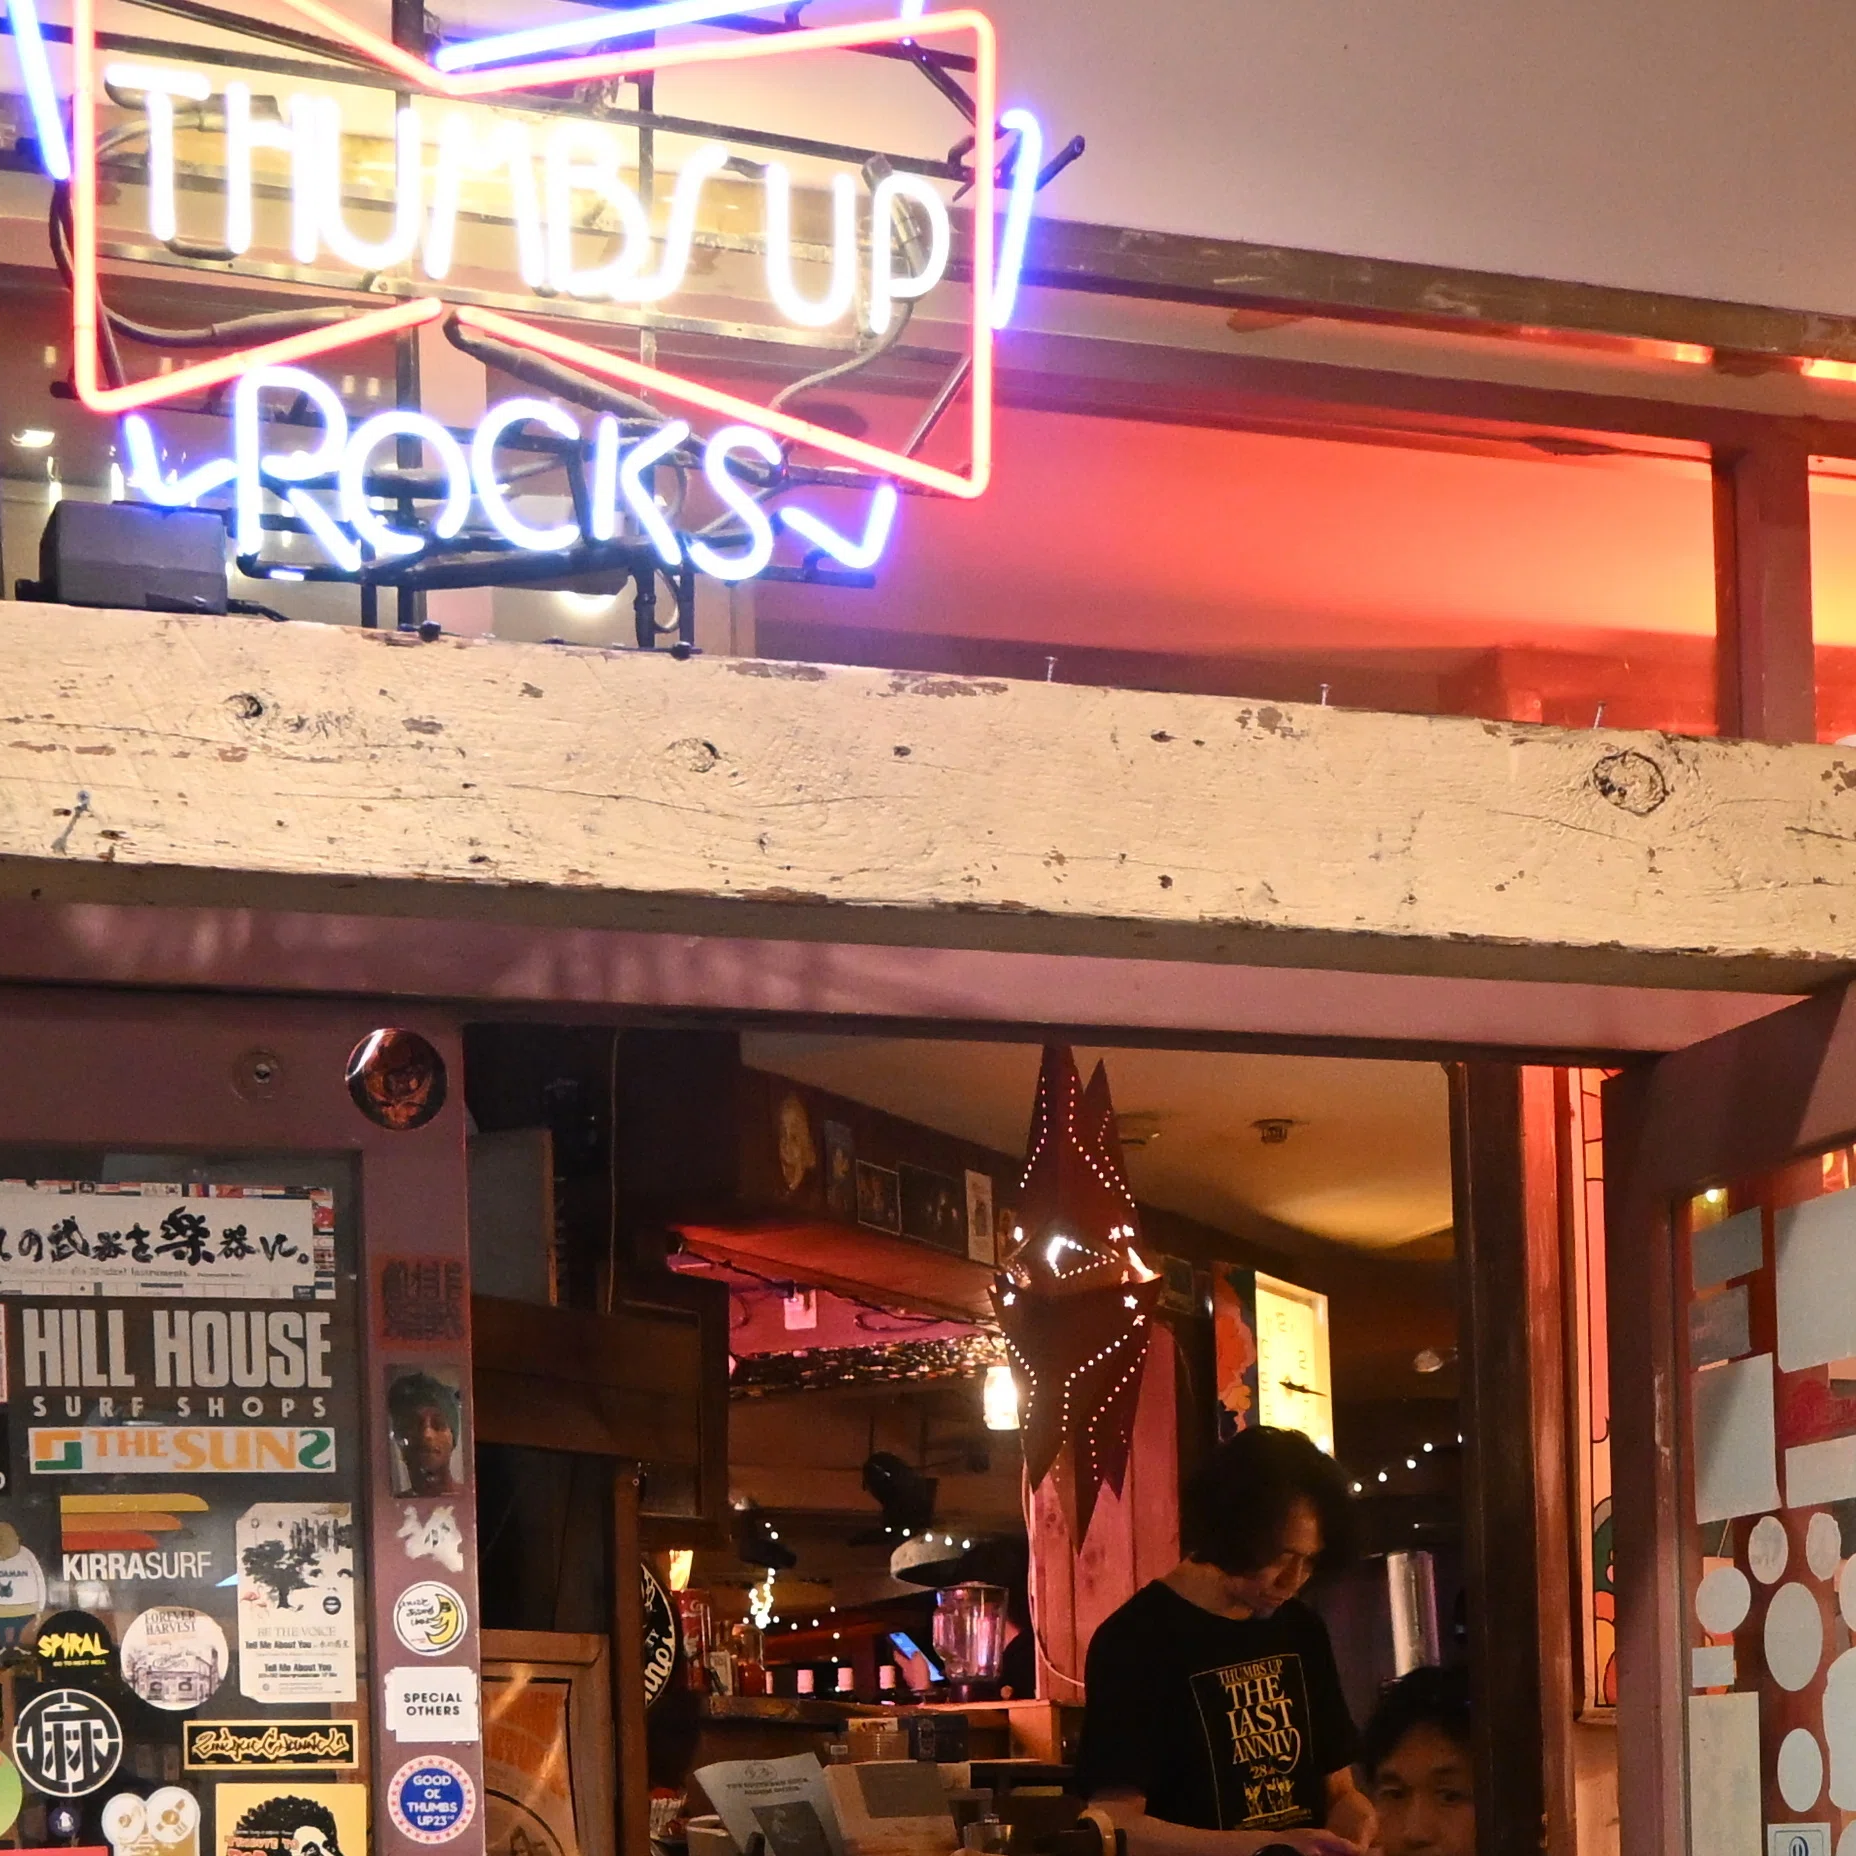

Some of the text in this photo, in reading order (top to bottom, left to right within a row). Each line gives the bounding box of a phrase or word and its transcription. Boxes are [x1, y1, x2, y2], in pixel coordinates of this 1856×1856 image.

[105, 61, 950, 336] THUMBS UP
[235, 364, 784, 581] ROCKS
[23, 1309, 332, 1389] HILL HOUSE
[33, 1396, 328, 1418] SURF SHOPS
[62, 1551, 213, 1582] KIRRASURF
[145, 1611, 195, 1624] FOREVER
[146, 1621, 197, 1634] HARVEST
[38, 1632, 110, 1659] SPIRAL
[1218, 1659, 1285, 1688] THUMBS UP
[403, 1692, 462, 1703] SPECIAL
[1225, 1676, 1286, 1705] THE
[406, 1704, 460, 1717] OTHERS
[1230, 1701, 1293, 1739] LAST
[413, 1774, 452, 1786] GOOD
[407, 1801, 458, 1812] THUMBS
